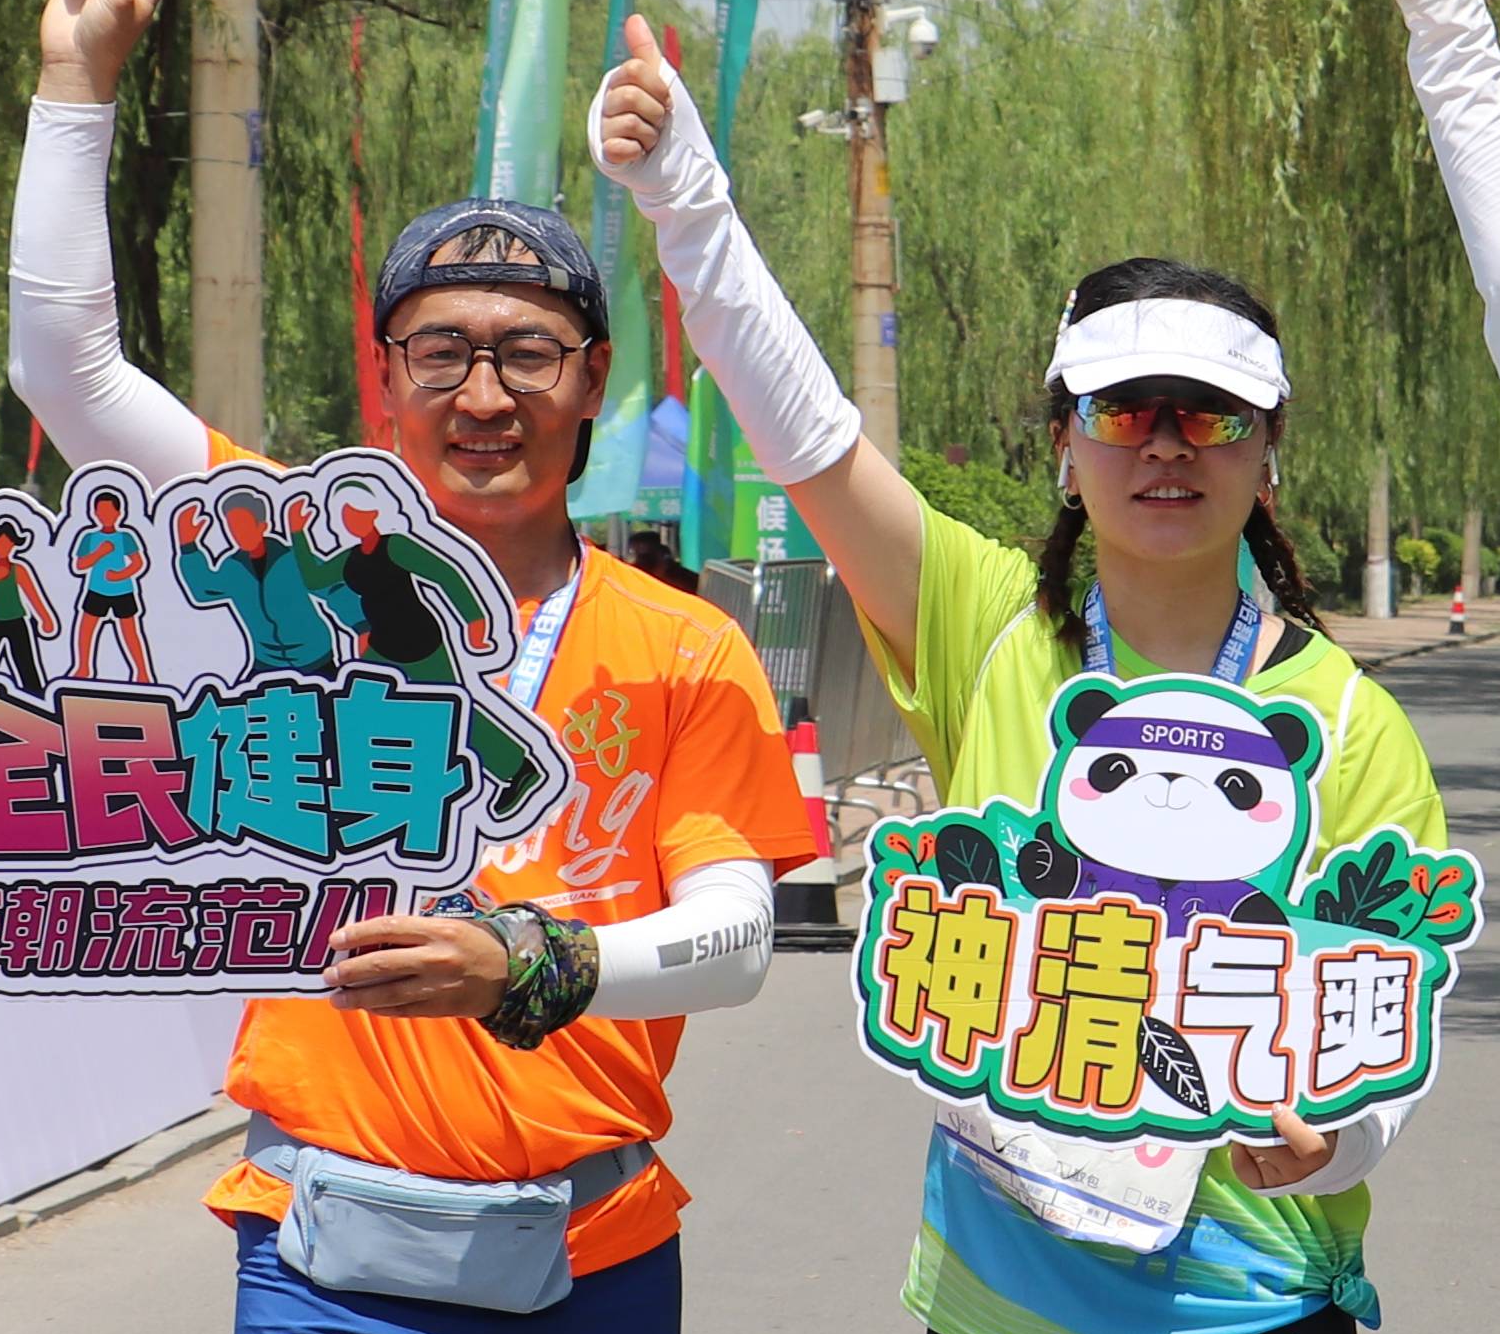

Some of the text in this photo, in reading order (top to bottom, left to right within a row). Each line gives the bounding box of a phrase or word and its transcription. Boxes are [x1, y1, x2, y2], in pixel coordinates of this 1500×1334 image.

[1139, 722, 1227, 753] SPORTS
[885, 884, 1410, 1109] 神清气爽
[1143, 1193, 1174, 1216] 收容
